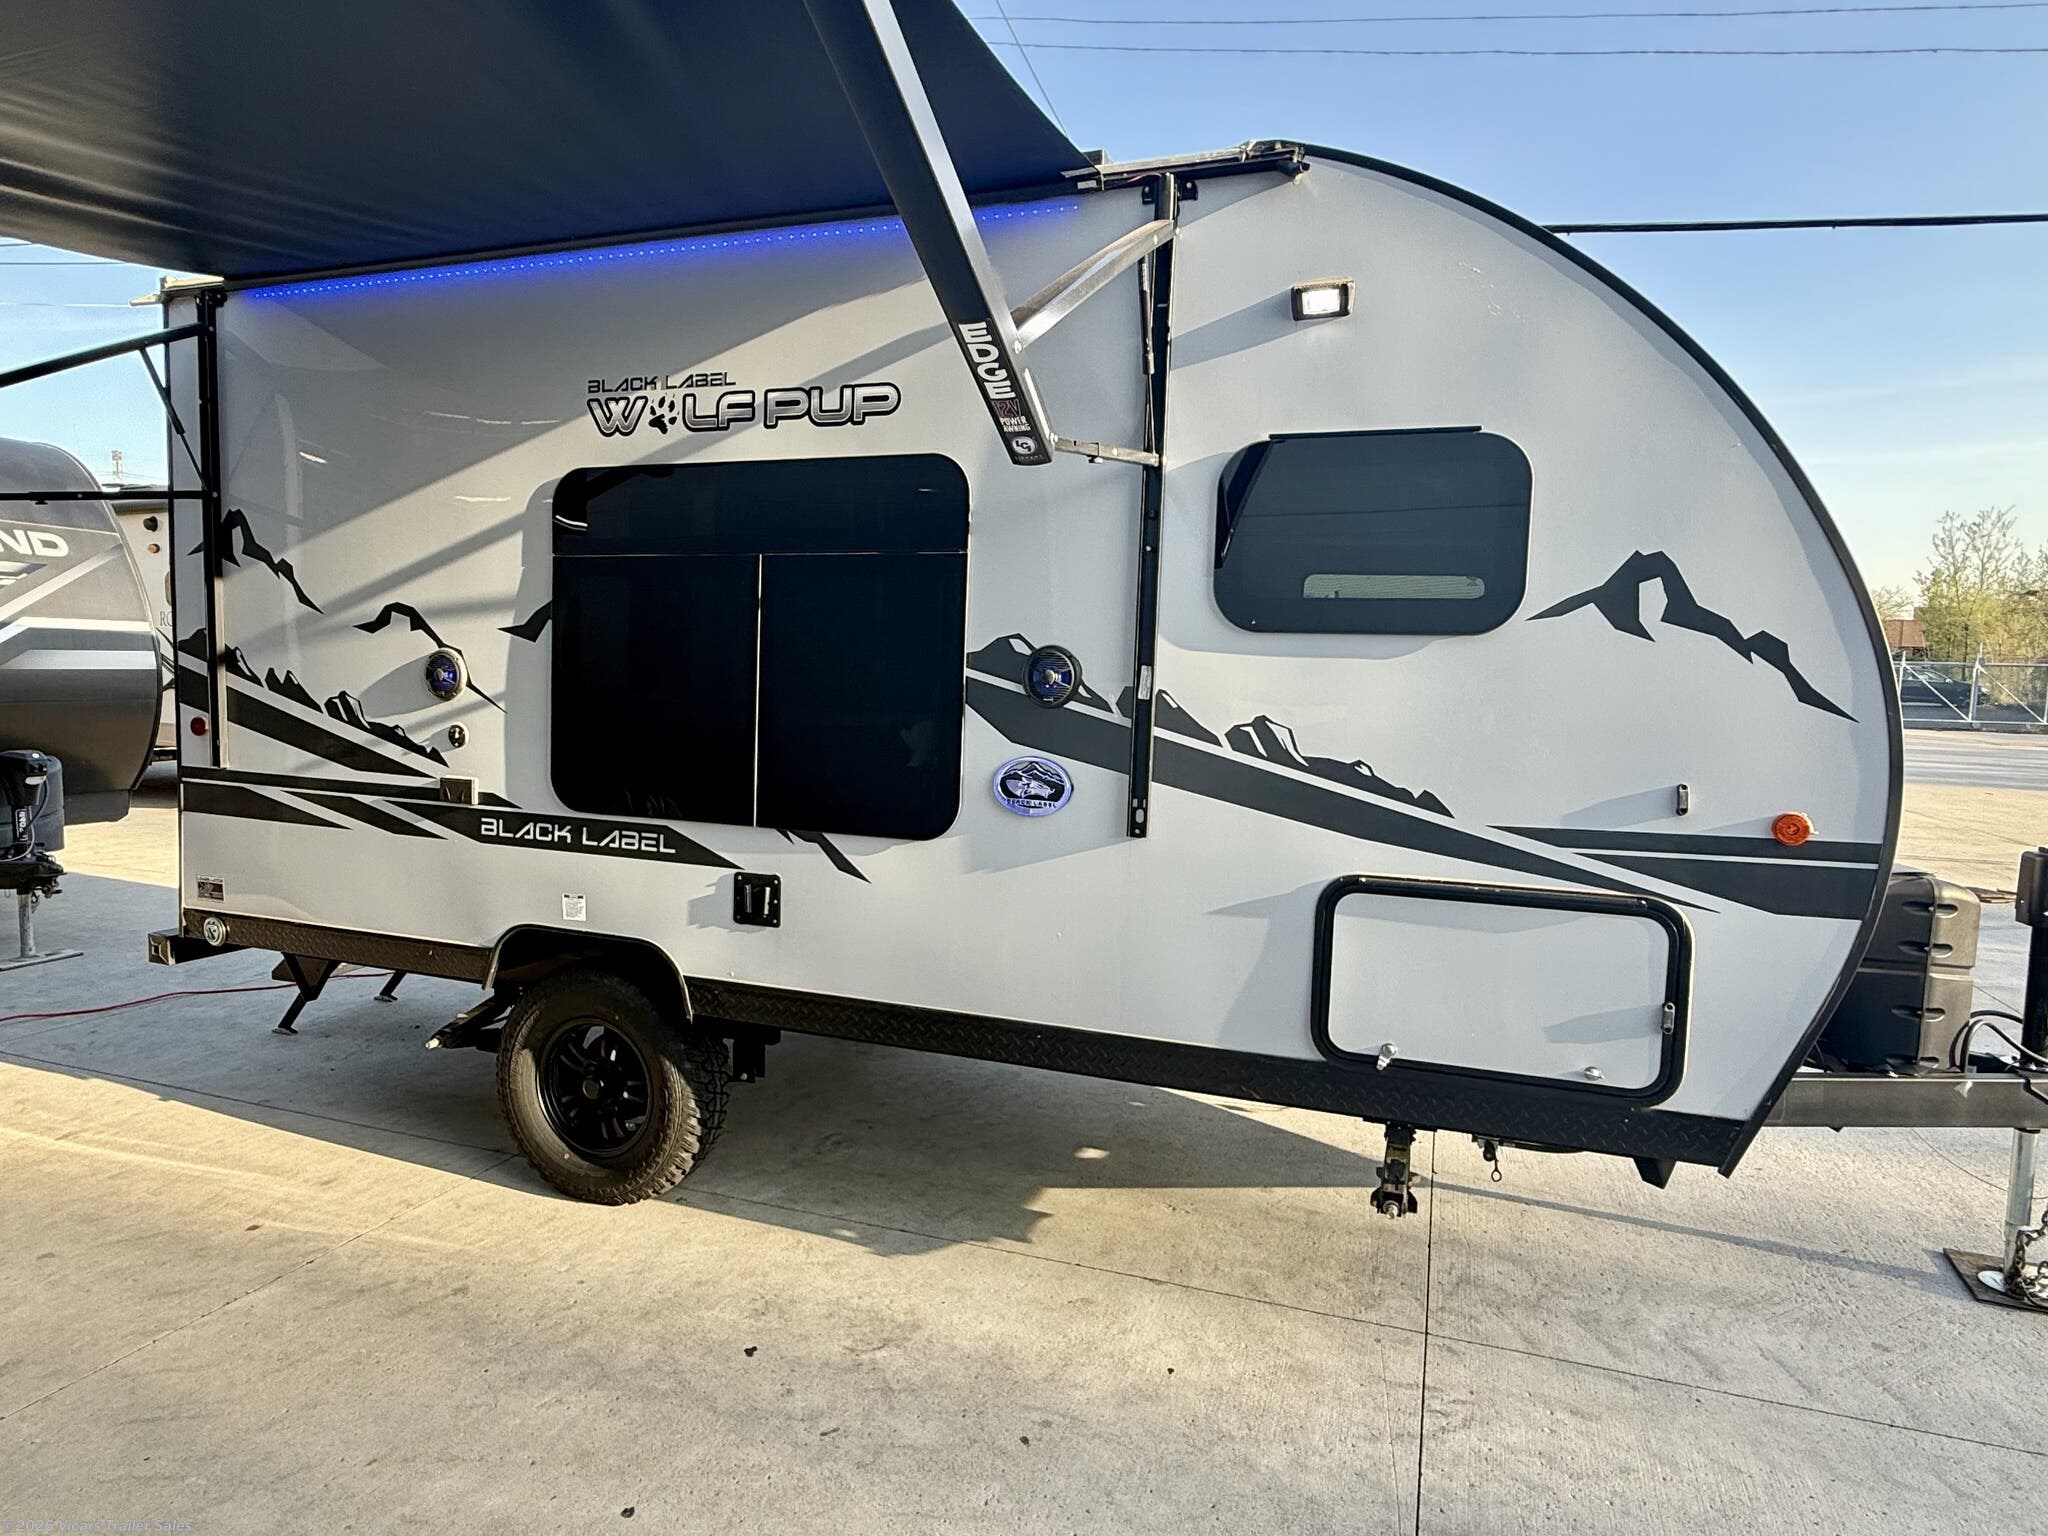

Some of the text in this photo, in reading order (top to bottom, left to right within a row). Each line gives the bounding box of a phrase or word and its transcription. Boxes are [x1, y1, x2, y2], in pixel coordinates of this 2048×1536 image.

[958, 321, 1016, 399] EDGE
[587, 372, 737, 393] BLACK LABEL
[763, 382, 901, 429] PUP
[999, 416, 1027, 425] POWER
[1003, 424, 1031, 432] AWNING
[1006, 799, 1057, 808] BLACK LABEL
[481, 817, 676, 854] BLACK LABEL
